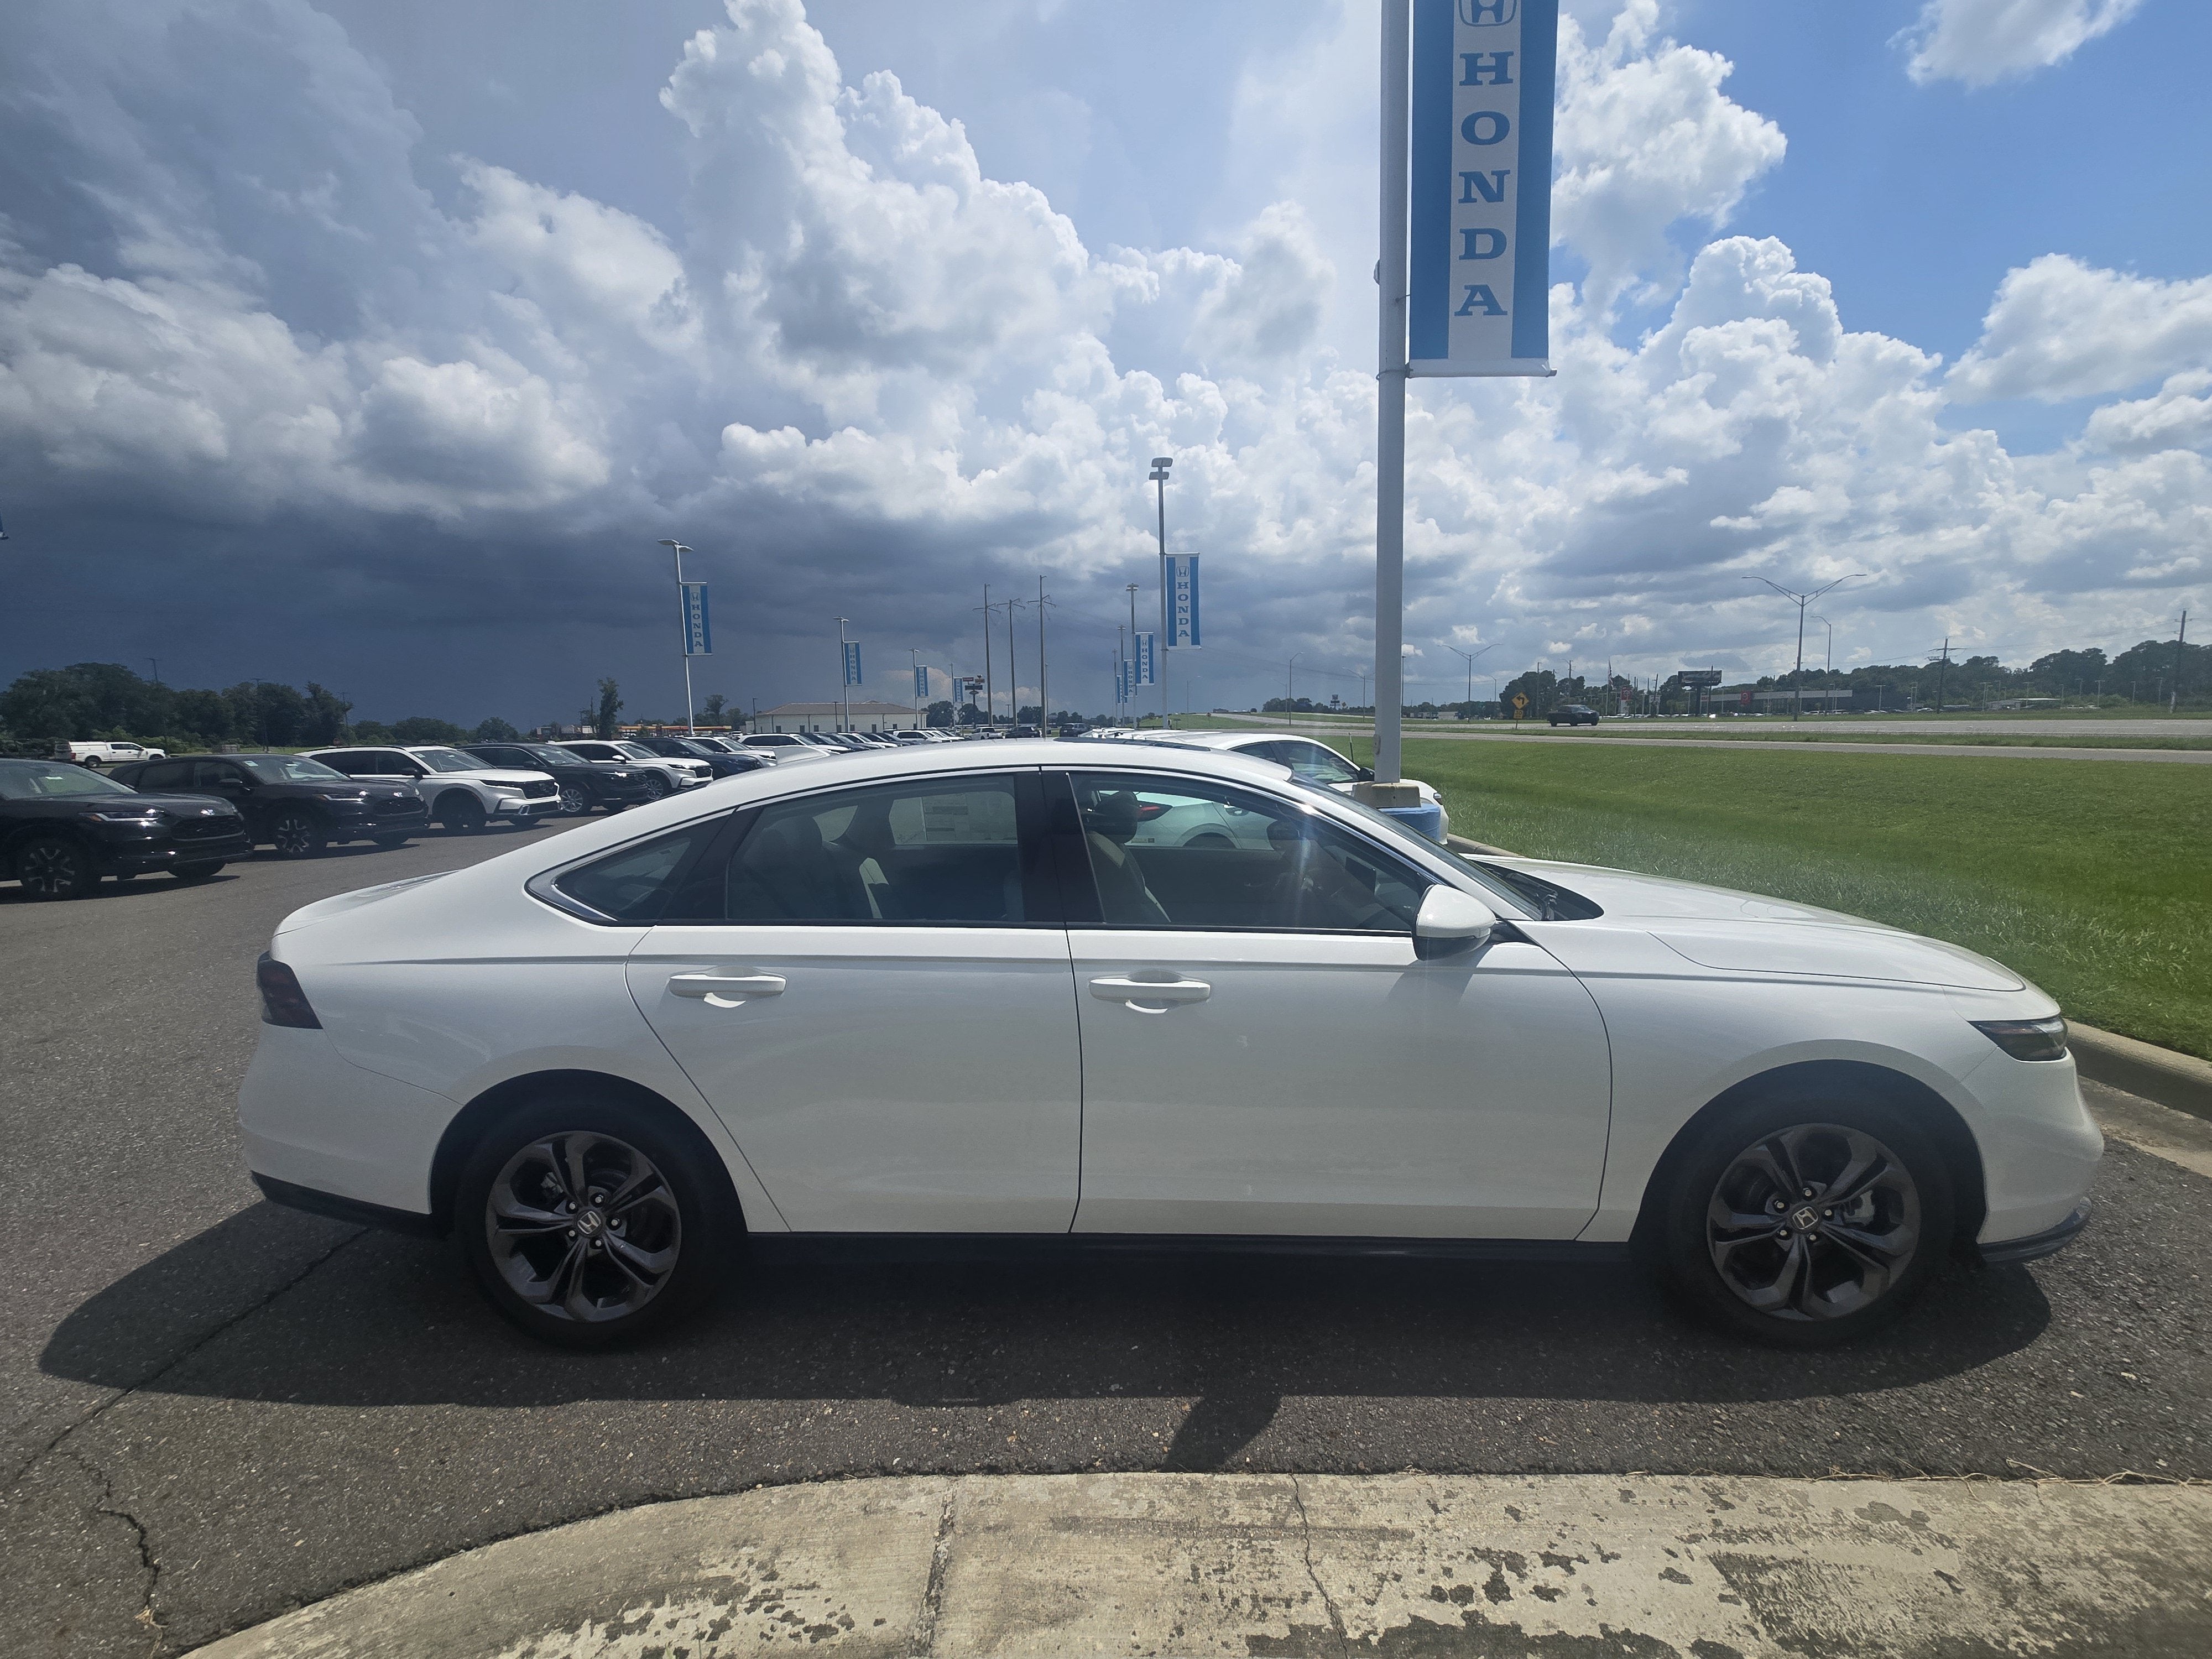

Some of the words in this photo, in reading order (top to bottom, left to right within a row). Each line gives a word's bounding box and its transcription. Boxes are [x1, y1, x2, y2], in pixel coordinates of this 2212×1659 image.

[1454, 51, 1514, 316] HONDA
[691, 604, 703, 647] HONDA
[1177, 581, 1190, 637] HONDA
